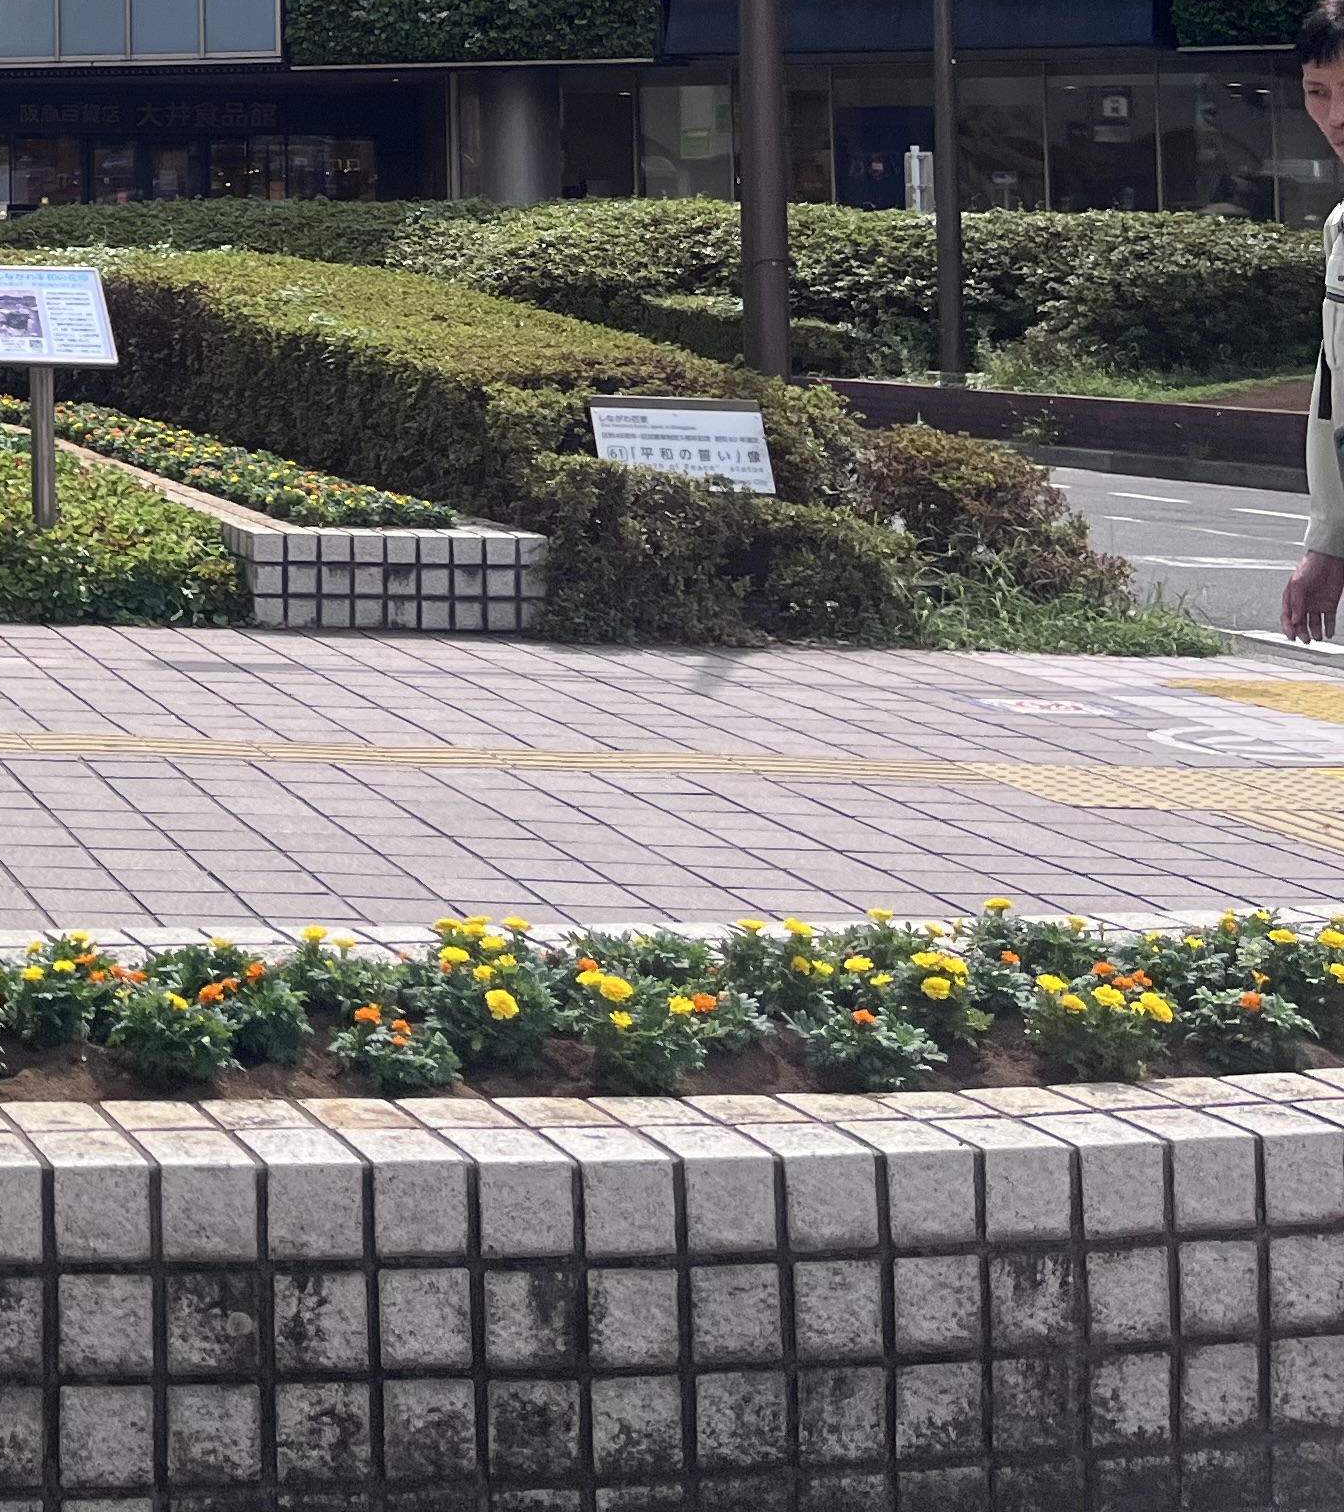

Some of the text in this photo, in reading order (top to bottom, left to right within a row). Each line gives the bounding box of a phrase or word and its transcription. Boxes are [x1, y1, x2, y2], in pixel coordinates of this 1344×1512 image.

[135, 102, 278, 128] 大井食品館
